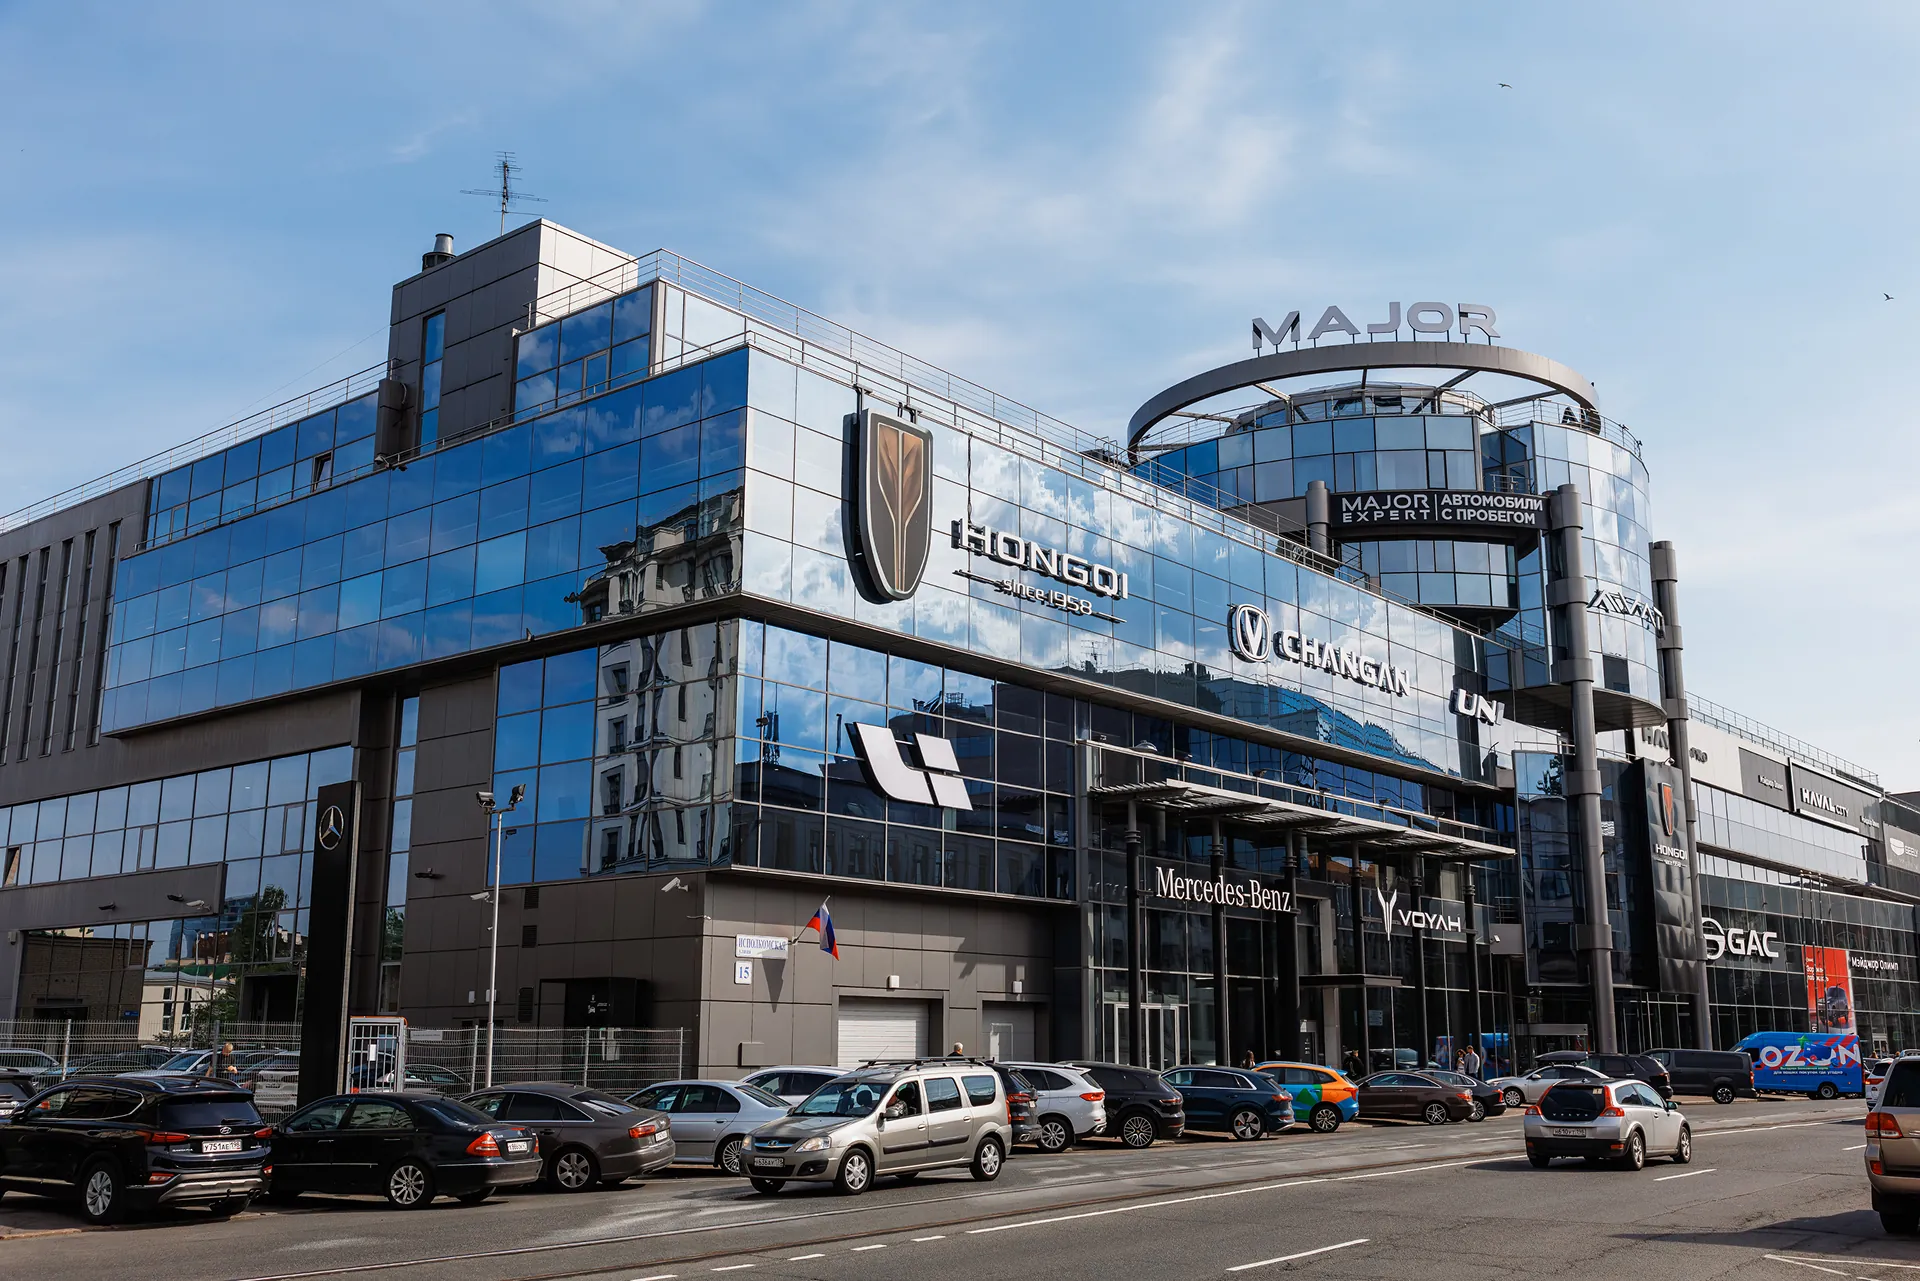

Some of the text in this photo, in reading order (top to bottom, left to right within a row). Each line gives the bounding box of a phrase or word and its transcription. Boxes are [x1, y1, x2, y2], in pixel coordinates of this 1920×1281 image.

[1252, 301, 1501, 349] MAJOR
[1342, 494, 1430, 512] MAJOR
[1440, 494, 1543, 512] АВТОМОБИЛИ
[1342, 509, 1431, 523] EXPERT
[1441, 509, 1536, 525] С ПРОБЕГОМ
[956, 518, 1129, 600] HONGQI
[1003, 577, 1094, 617] since 1958
[1278, 629, 1411, 697] CHANGAN
[1455, 688, 1506, 726] UNI
[1801, 787, 1836, 813] HAVAL
[1655, 843, 1688, 860] HONGQI
[1156, 866, 1292, 912] Mercedes-Benz
[1398, 908, 1461, 933] VOYAH
[1727, 928, 1779, 958] GAC
[739, 966, 750, 979] 15
[1760, 1043, 1862, 1068] OZON
